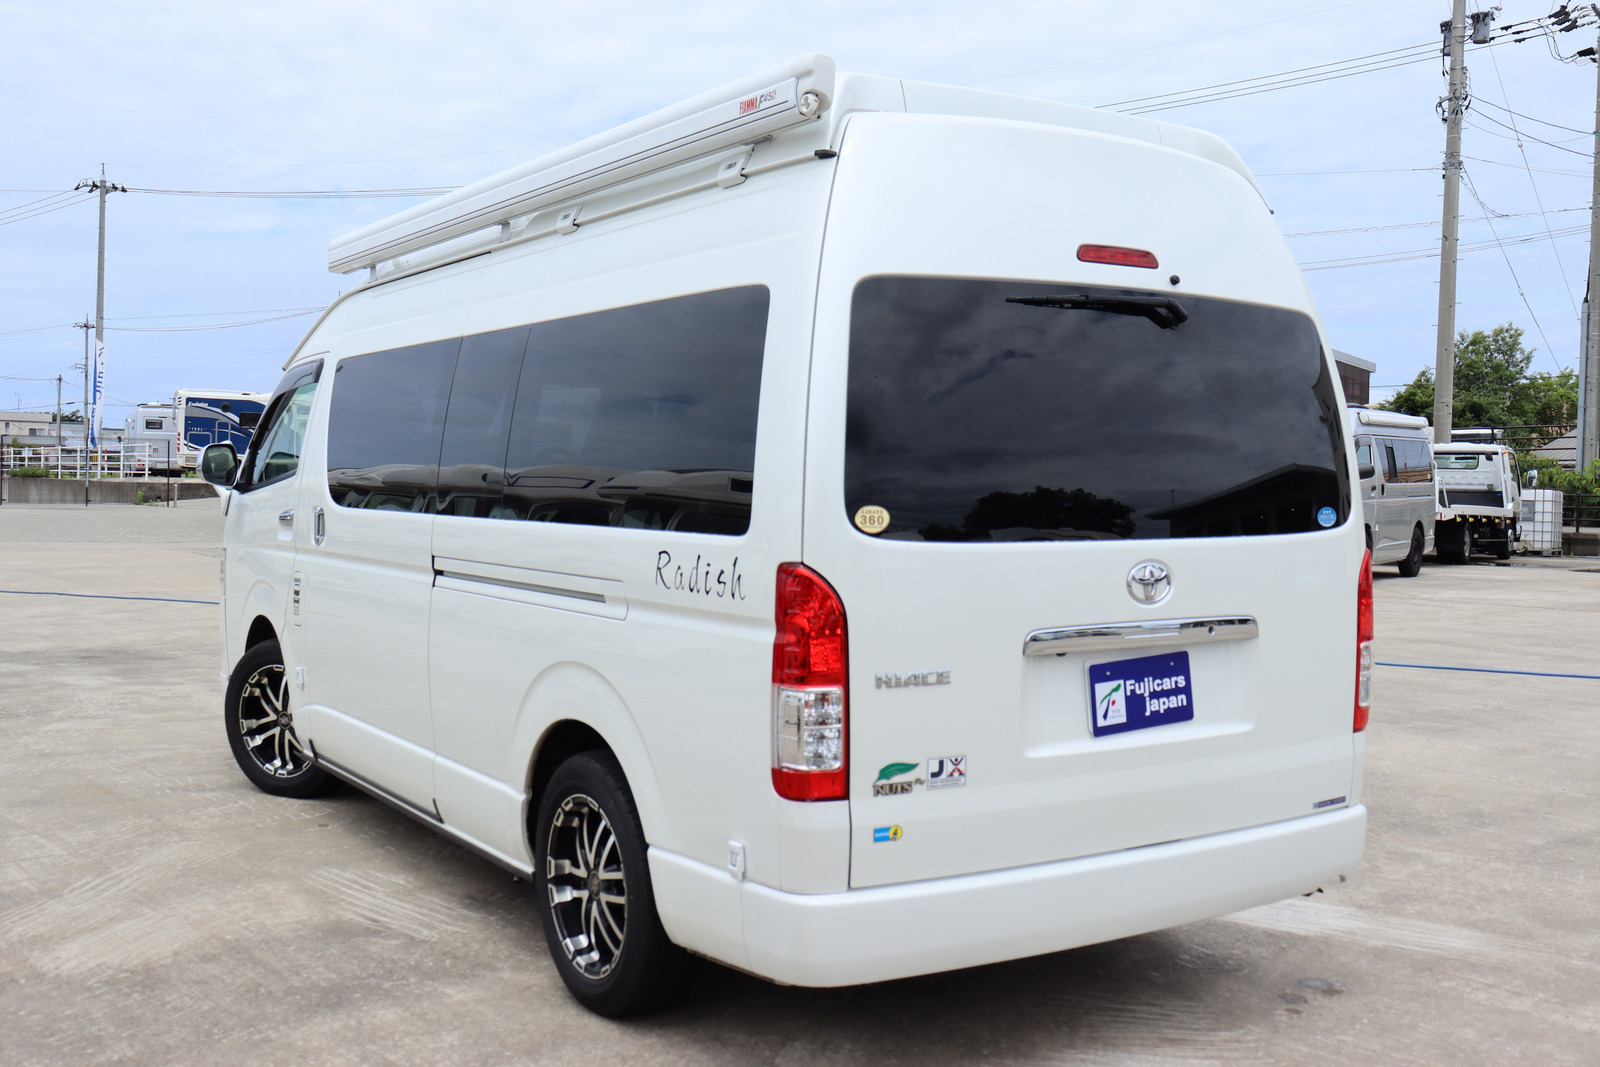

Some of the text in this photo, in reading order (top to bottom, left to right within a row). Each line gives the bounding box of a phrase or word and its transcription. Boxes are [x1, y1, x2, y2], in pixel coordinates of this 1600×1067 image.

[739, 97, 758, 115] FIAMMA
[860, 515, 884, 525] 360
[655, 550, 746, 600] Radish
[875, 668, 951, 689] HIACE
[1126, 675, 1186, 696] Fujicars
[1145, 694, 1187, 716] japan
[873, 781, 913, 797] NUTS
